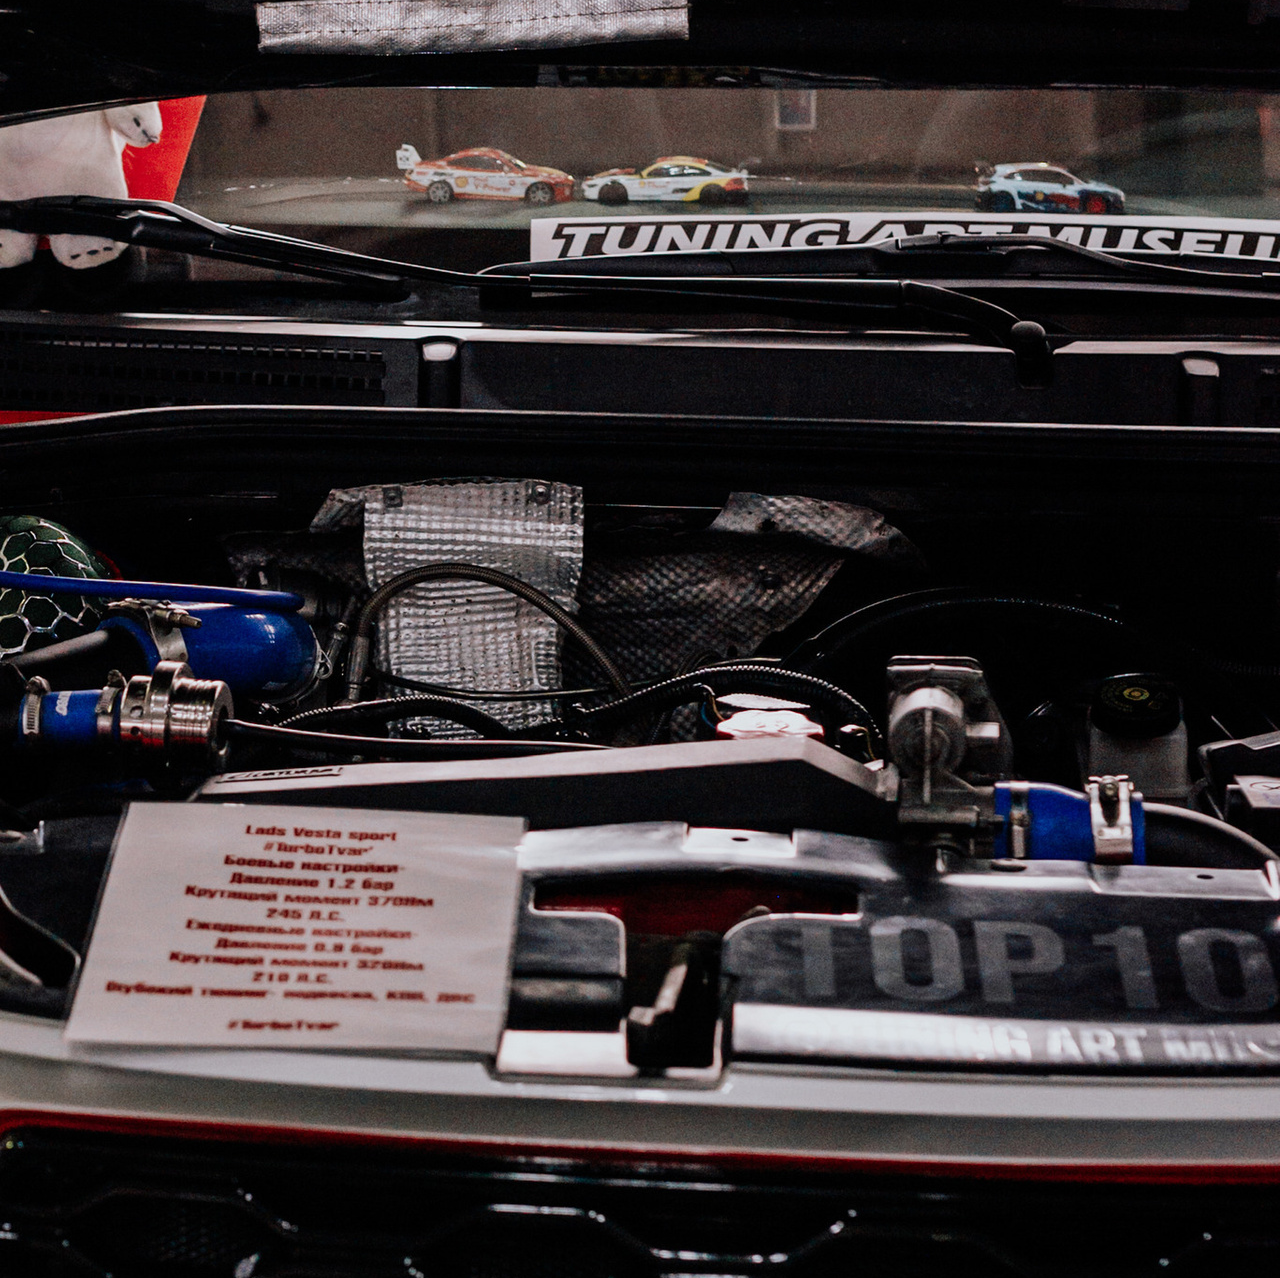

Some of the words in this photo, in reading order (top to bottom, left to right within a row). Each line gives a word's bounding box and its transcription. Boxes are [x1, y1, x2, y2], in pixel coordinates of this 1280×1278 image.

[554, 219, 850, 259] TUNING
[1026, 224, 1280, 256] MUSEU
[293, 827, 341, 839] Vesta
[348, 831, 397, 842] sport
[224, 854, 295, 869] Боевые
[229, 872, 319, 888] Давление
[328, 877, 355, 890] 1.2
[361, 877, 395, 891] бар
[185, 885, 278, 902] Крутящий
[284, 894, 360, 906] момент
[266, 908, 302, 920] 245
[215, 937, 307, 951] Давление
[350, 941, 384, 955] бар
[169, 951, 265, 965] Крутящий
[270, 958, 348, 969] момент
[778, 918, 1065, 1004] TOP
[1092, 925, 1280, 1012] 10
[1046, 1027, 1148, 1063] ART
